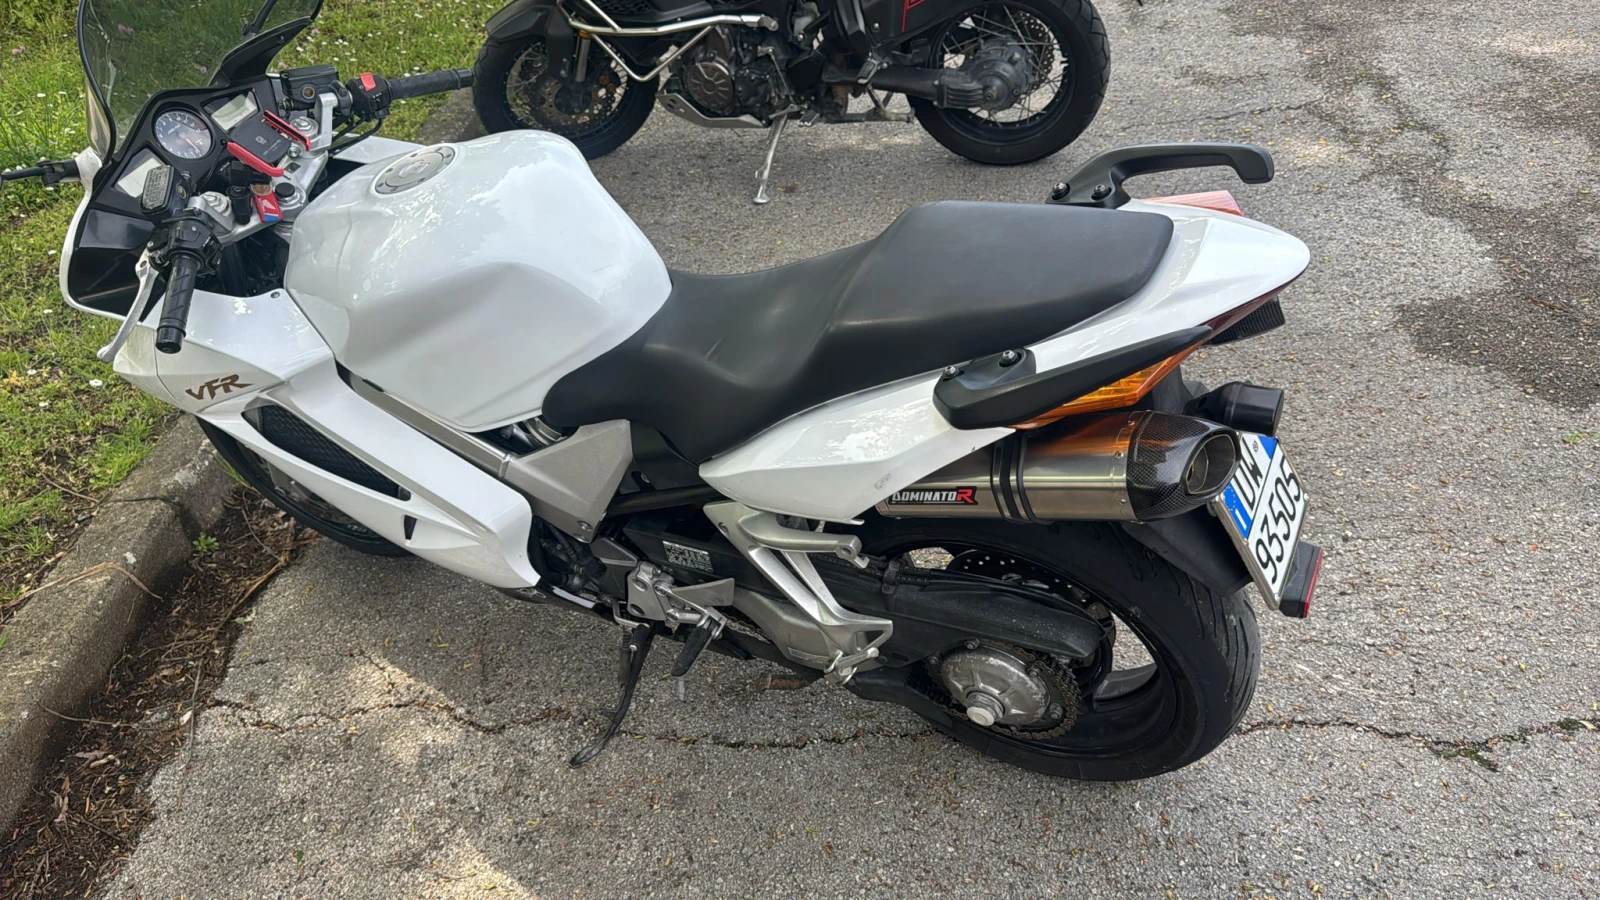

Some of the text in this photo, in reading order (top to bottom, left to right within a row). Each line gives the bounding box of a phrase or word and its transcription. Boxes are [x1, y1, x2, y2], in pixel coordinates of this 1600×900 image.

[185, 373, 254, 400] VFR
[892, 489, 974, 504] DOMINATOR
[1255, 456, 1301, 584] 93505
